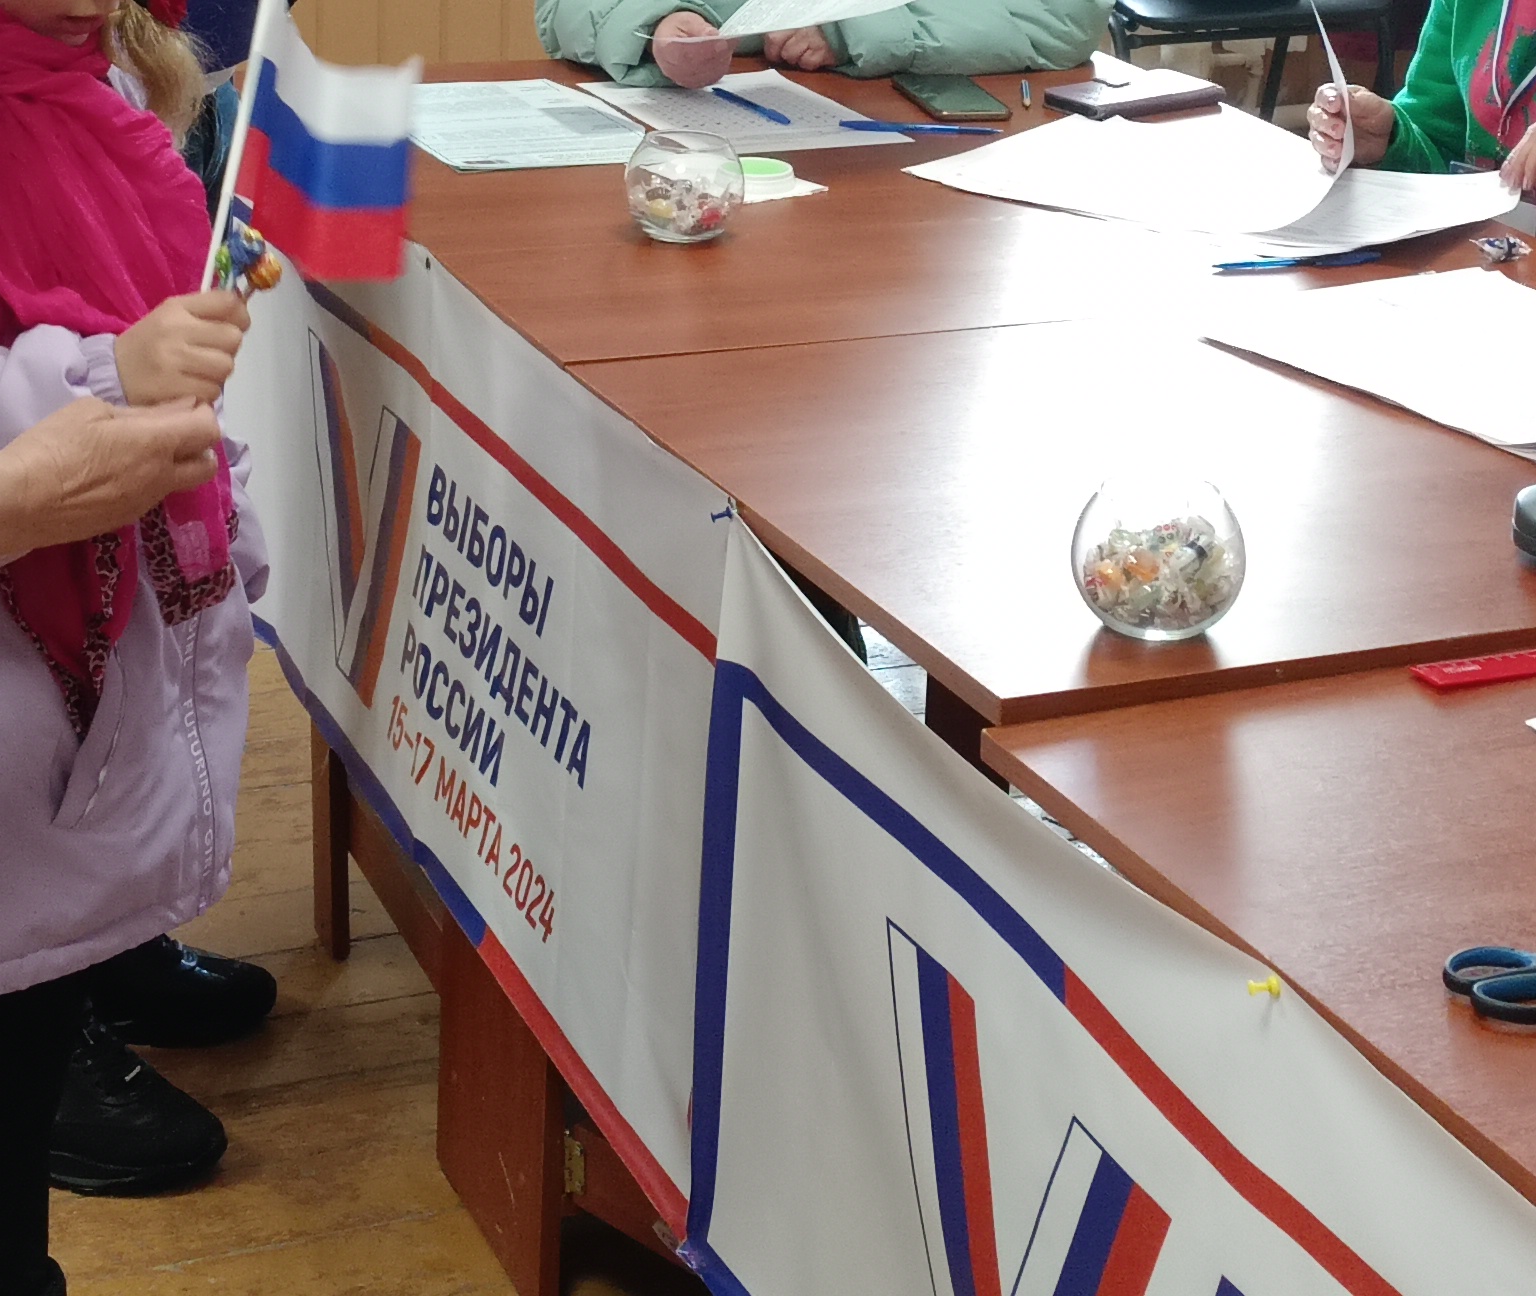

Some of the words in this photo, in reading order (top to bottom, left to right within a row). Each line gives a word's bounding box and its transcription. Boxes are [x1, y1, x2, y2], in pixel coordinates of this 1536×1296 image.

[426, 463, 554, 639] ВЫБОРЫ
[400, 619, 505, 788] РОССИИ
[413, 544, 591, 790] ПРЕЗИДЕНТА
[182, 698, 213, 816] FUTURINO
[434, 755, 503, 877] МАРТА
[502, 843, 555, 943] 2024
